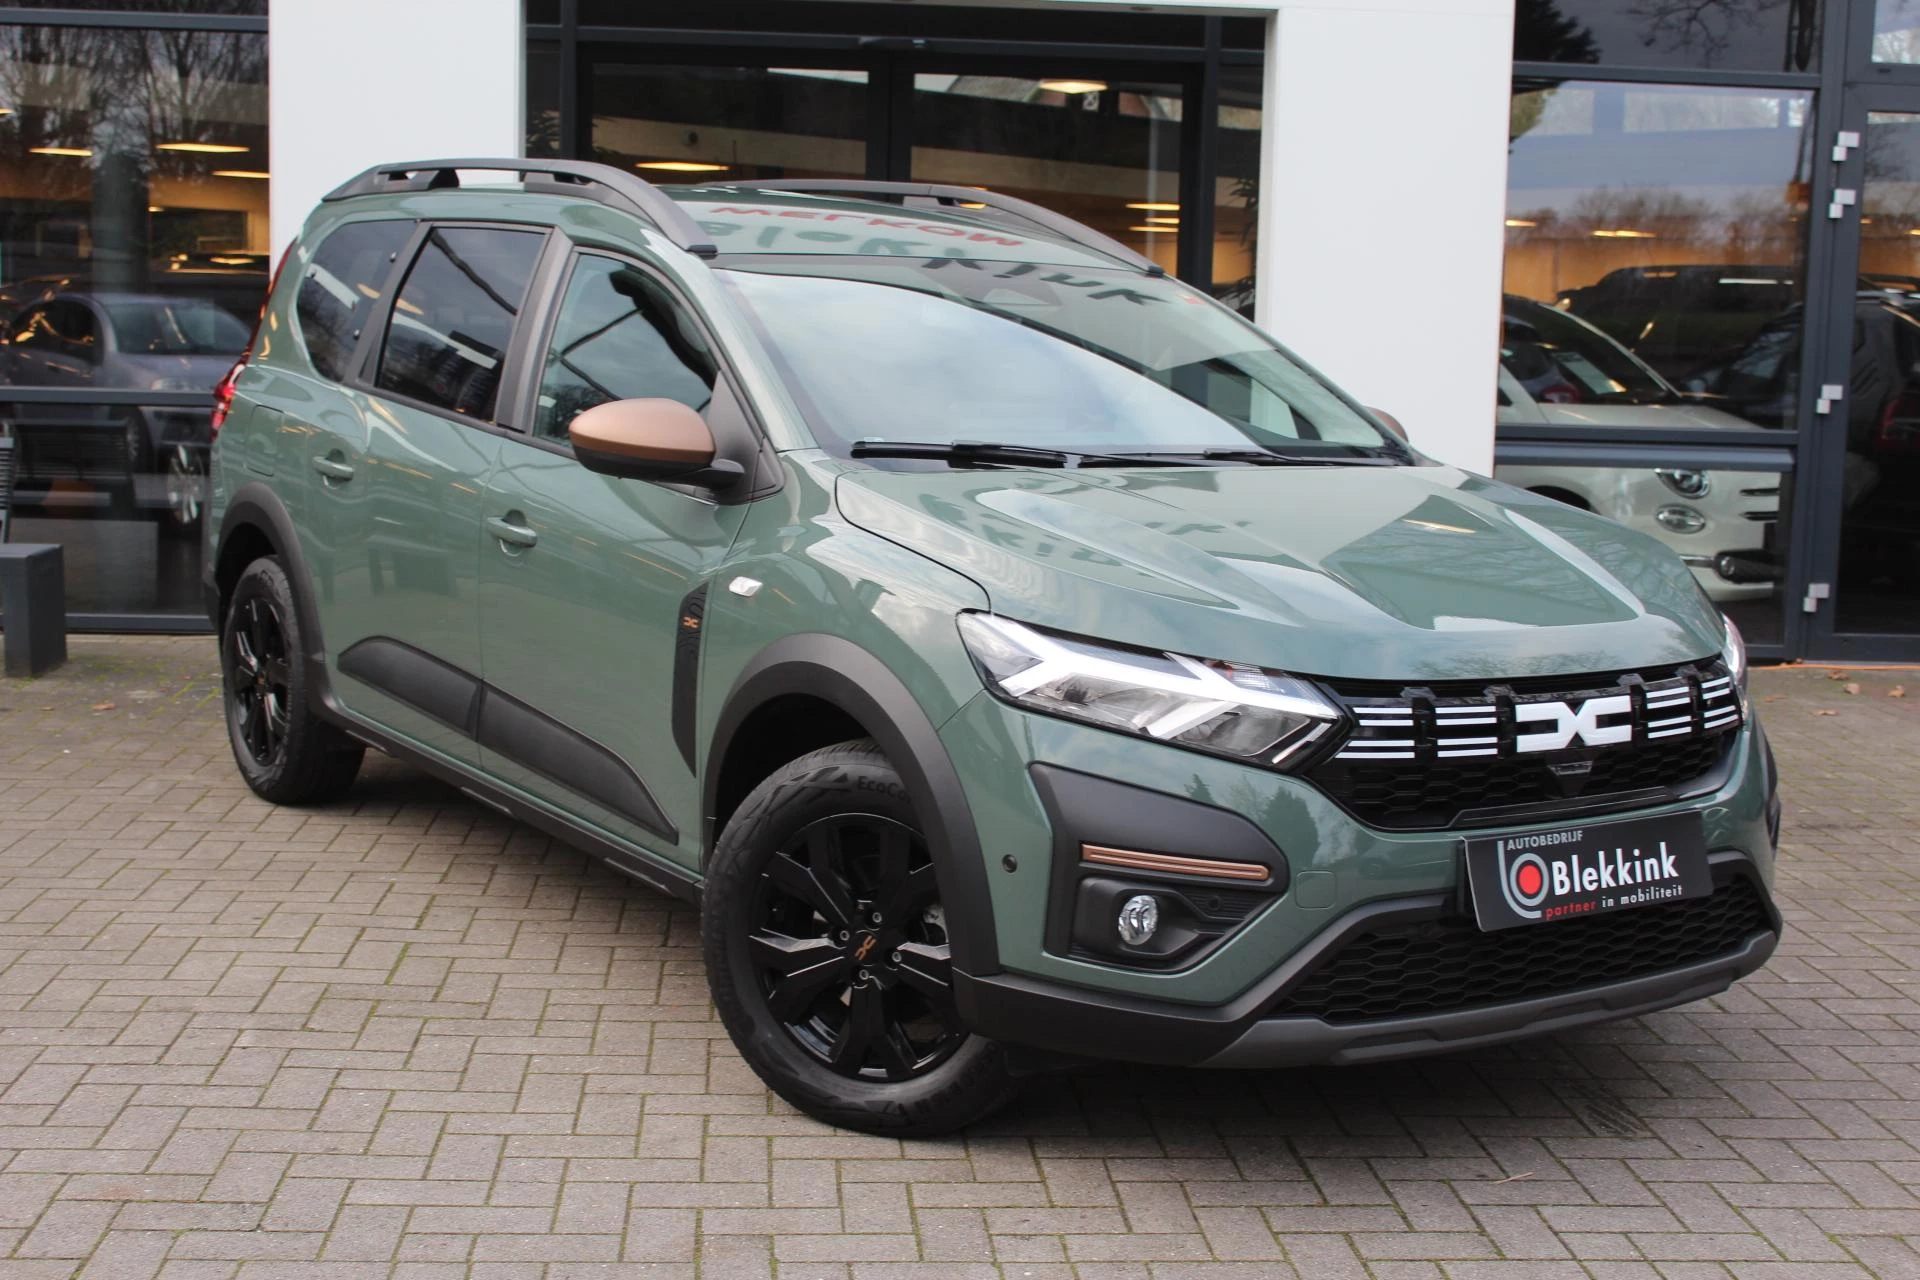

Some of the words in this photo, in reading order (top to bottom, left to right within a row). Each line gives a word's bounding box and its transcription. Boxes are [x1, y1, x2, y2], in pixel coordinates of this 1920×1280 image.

[1507, 831, 1583, 850] AUTOBEDRIJF
[1552, 842, 1680, 895] Blekkink
[1546, 902, 1596, 920] partner
[1602, 896, 1614, 908] in
[1620, 885, 1683, 905] mobiliteit
